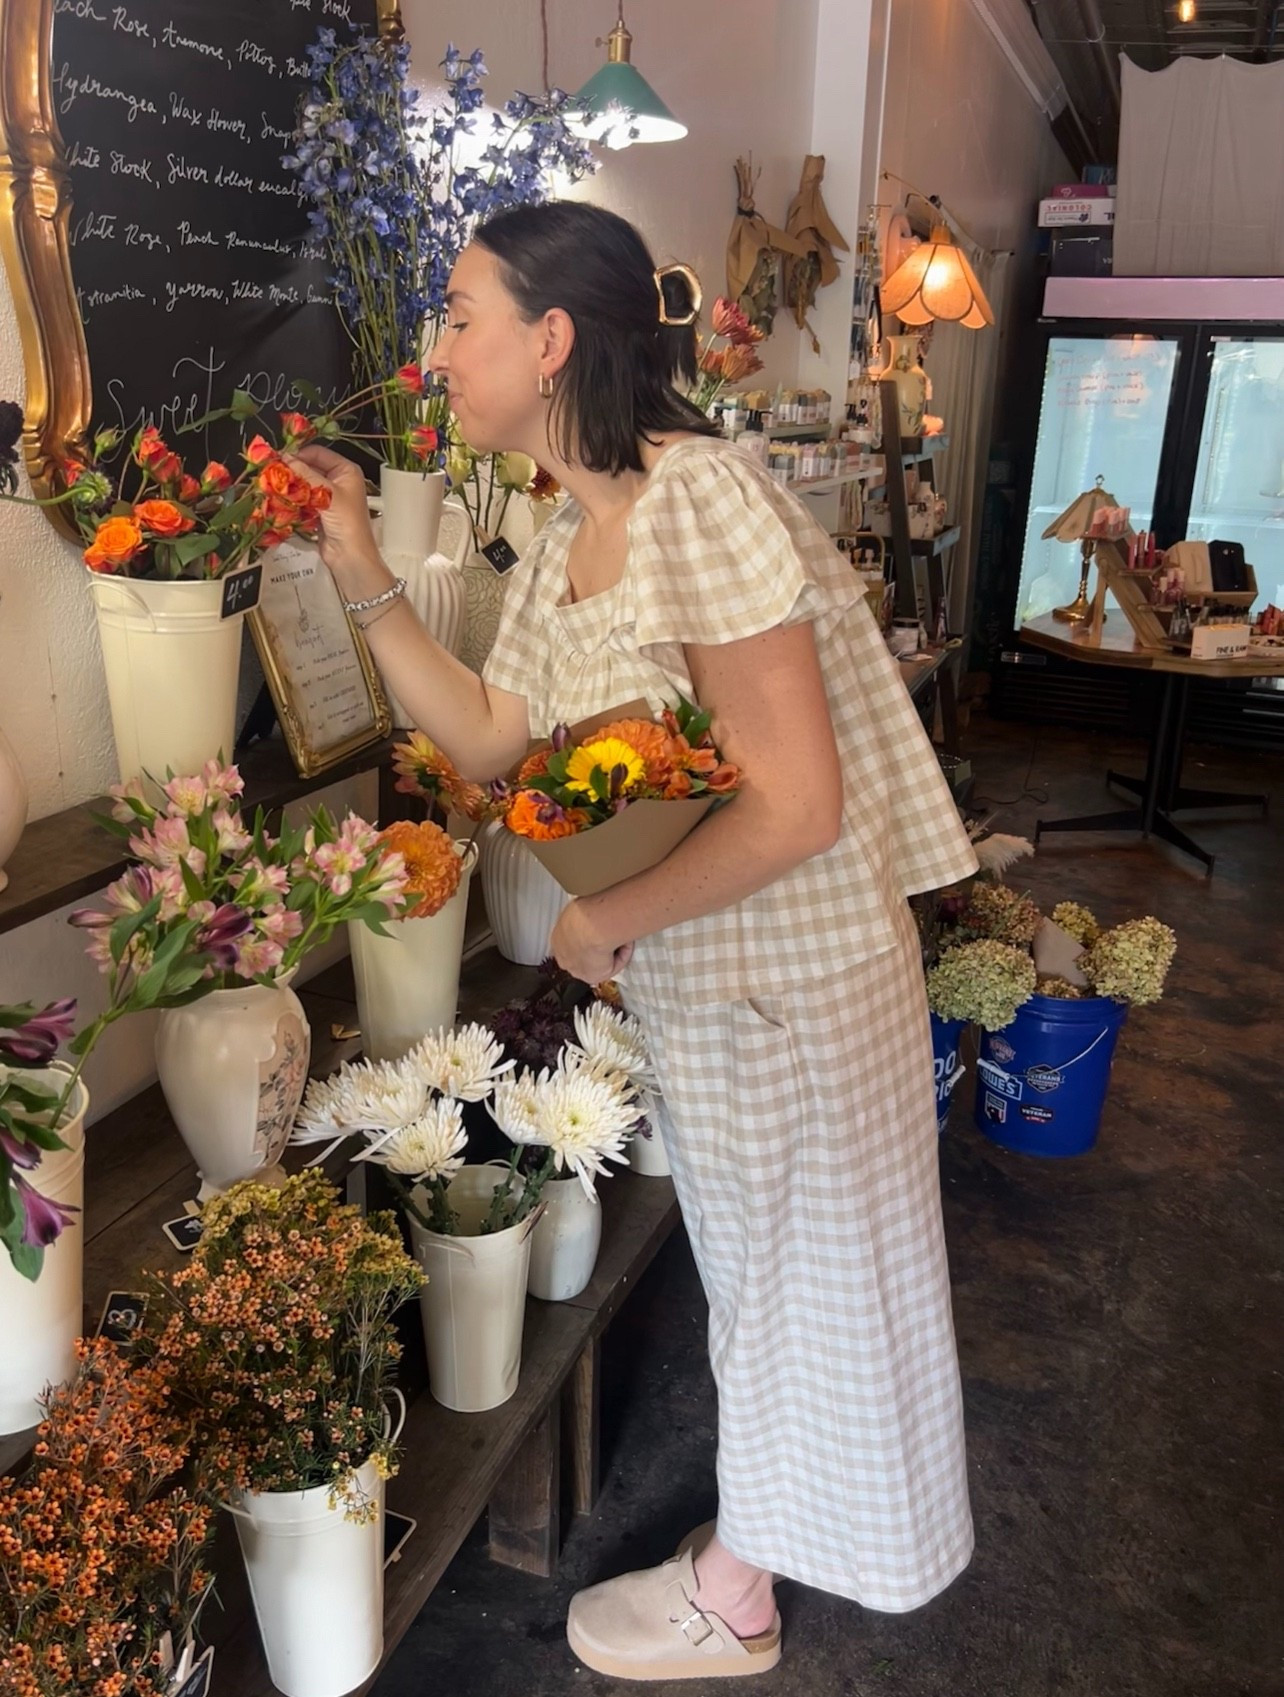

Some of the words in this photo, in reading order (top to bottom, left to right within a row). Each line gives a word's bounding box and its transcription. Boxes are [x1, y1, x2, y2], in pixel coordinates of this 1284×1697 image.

[53, 0, 106, 20] each
[169, 91, 202, 126] Wax
[65, 141, 100, 168] hite
[167, 153, 209, 184] Silver
[231, 280, 263, 299] White
